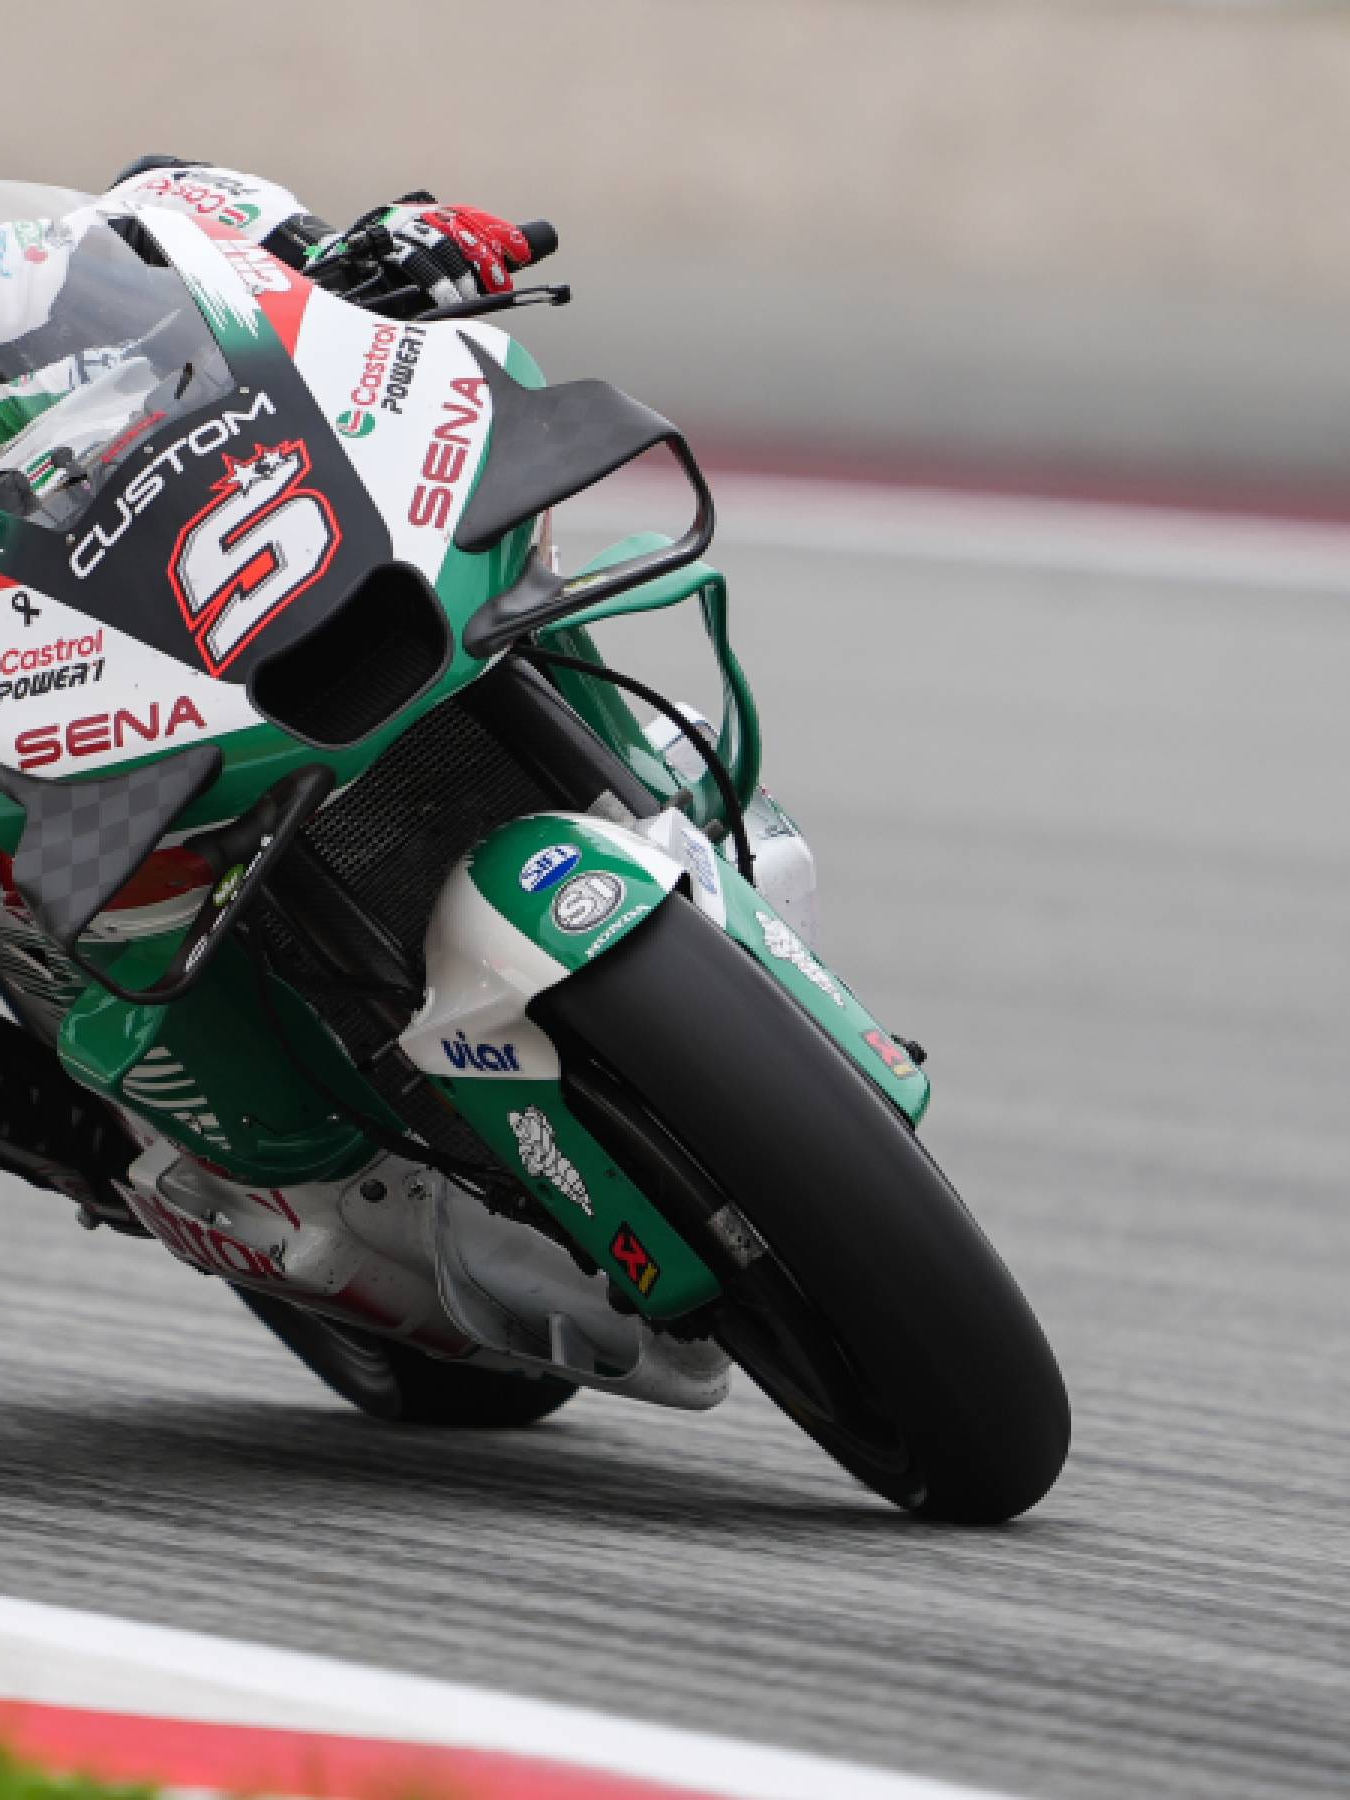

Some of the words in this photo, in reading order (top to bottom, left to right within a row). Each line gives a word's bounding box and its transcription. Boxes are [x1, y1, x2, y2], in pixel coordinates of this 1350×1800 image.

[350, 323, 398, 406] Castrol
[380, 323, 427, 415] POWER1
[69, 391, 278, 579] CUSTOM
[407, 377, 489, 529] SENA
[0, 628, 105, 676] Castrol
[14, 695, 207, 774] SENA
